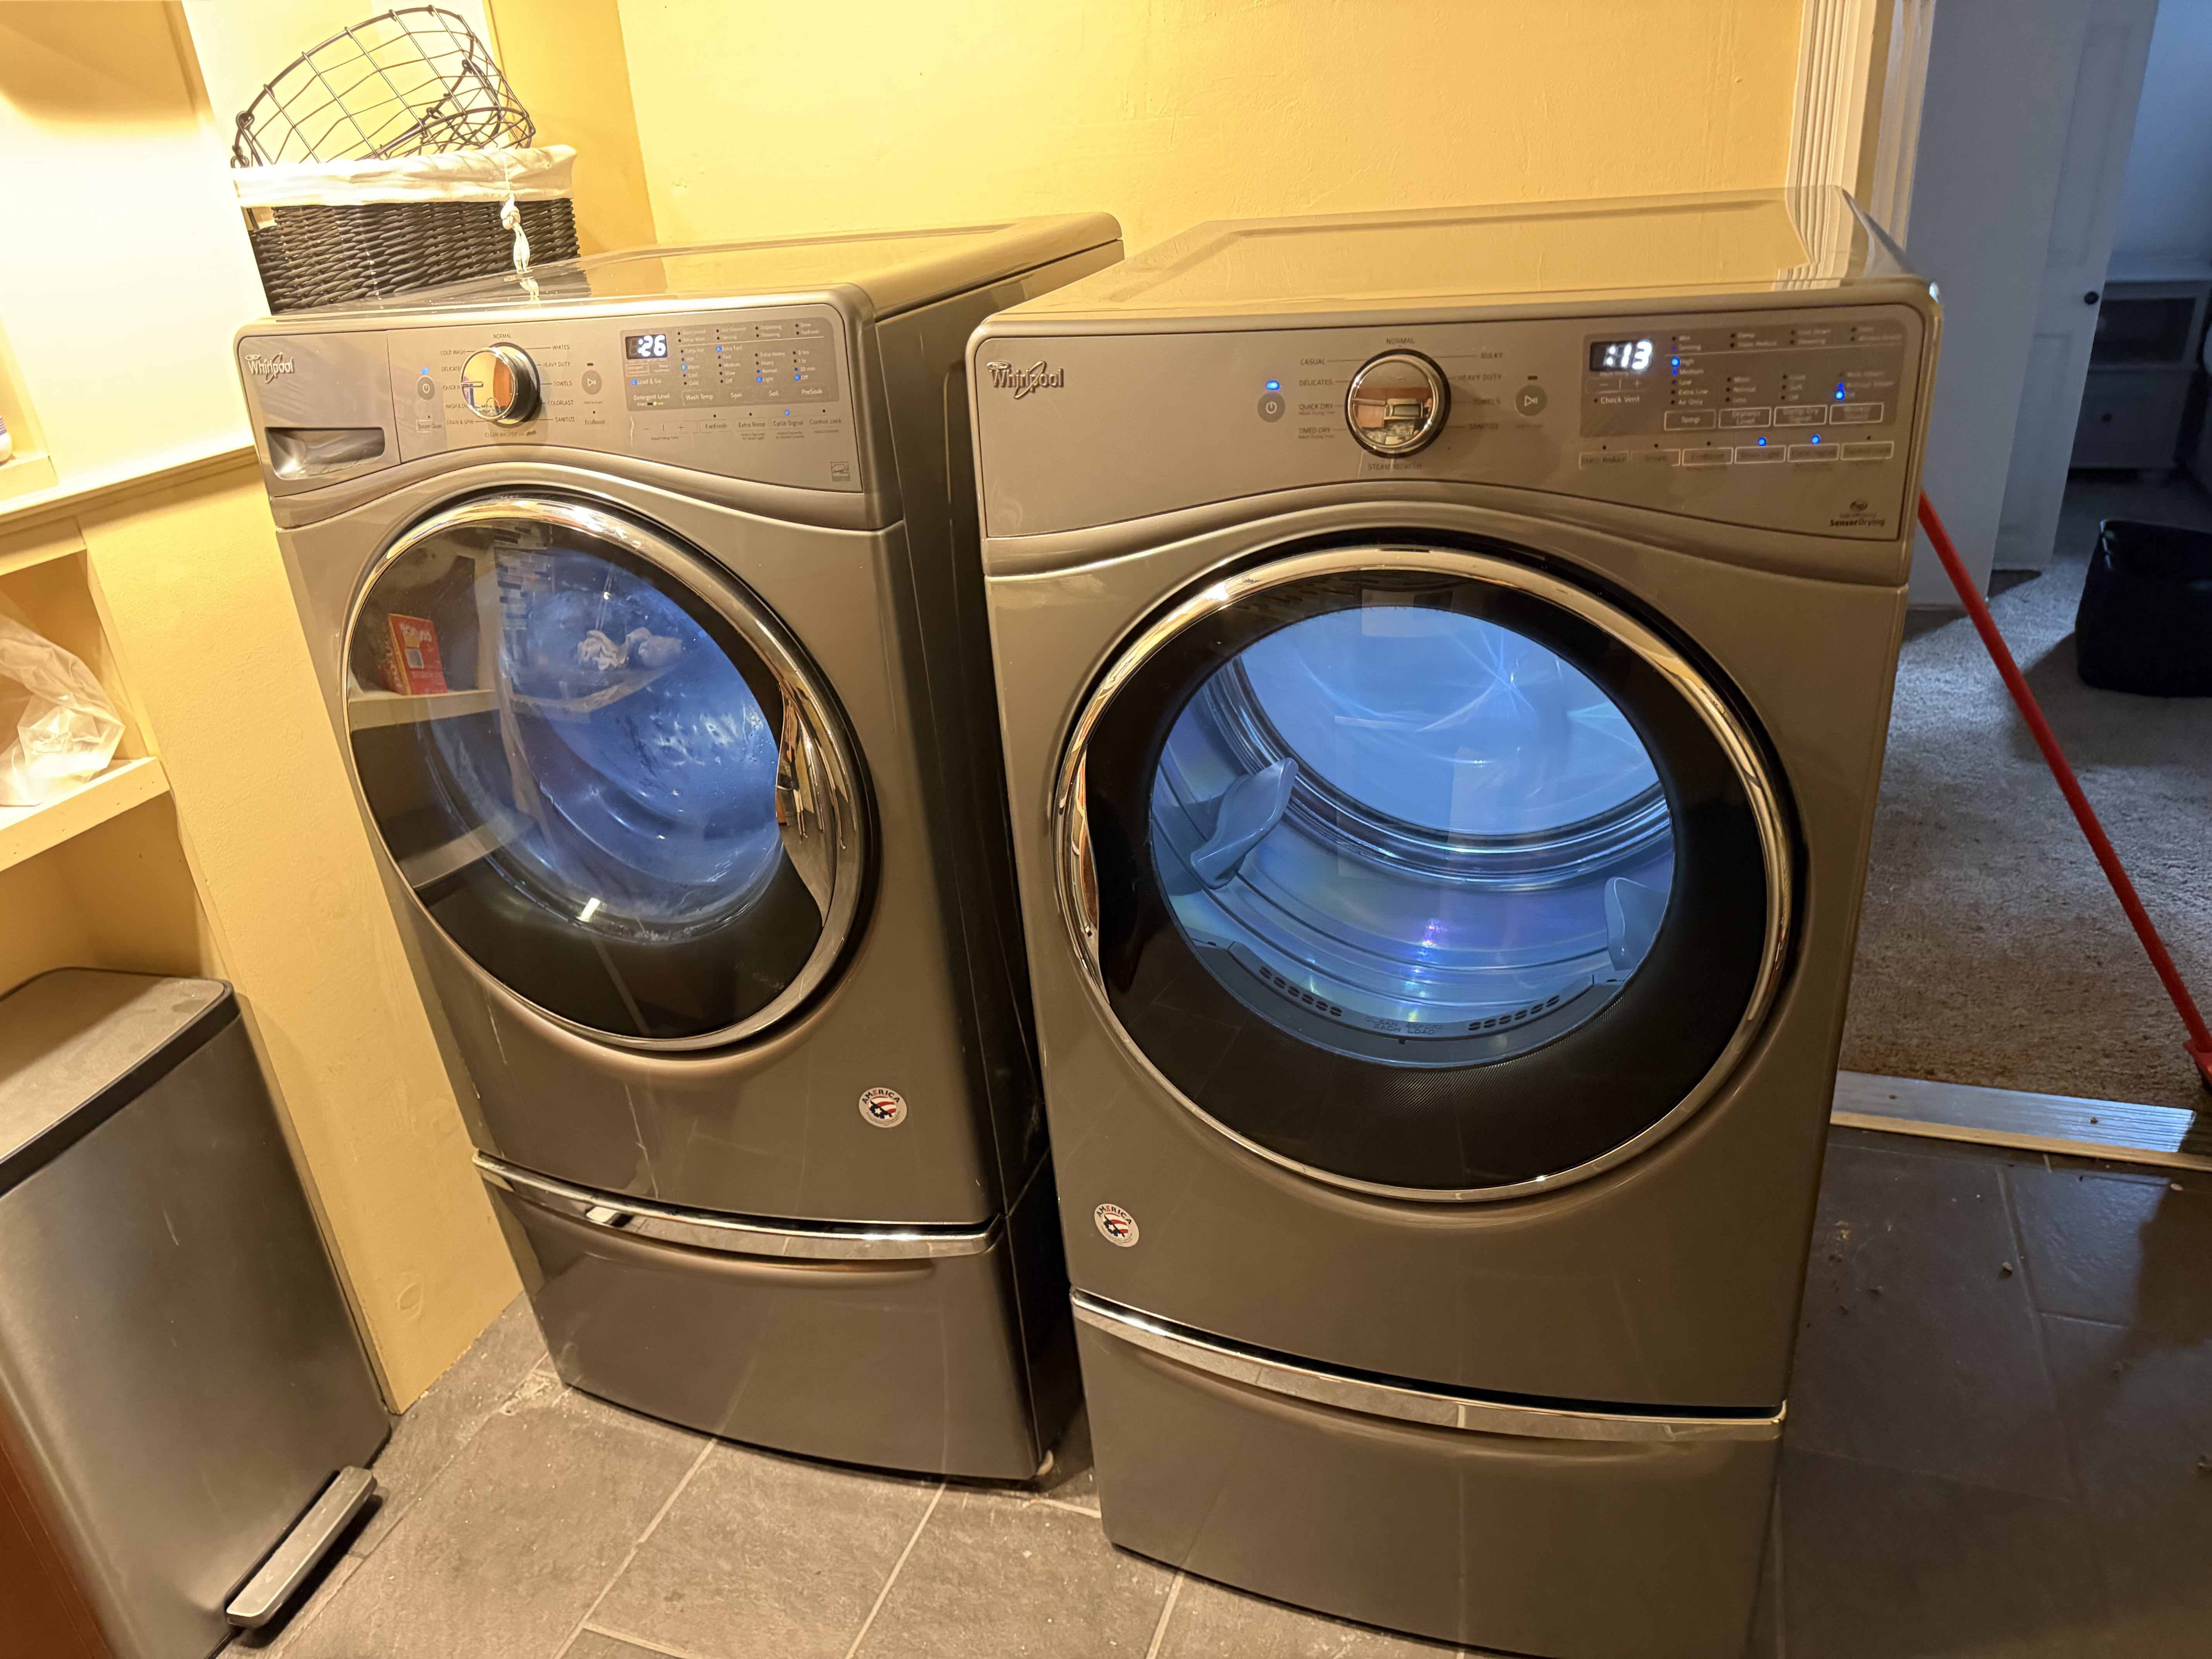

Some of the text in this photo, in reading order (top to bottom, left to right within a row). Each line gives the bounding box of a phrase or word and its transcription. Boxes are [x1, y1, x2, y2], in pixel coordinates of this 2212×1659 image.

[247, 354, 294, 381] Whirlpool
[988, 364, 1065, 397] Whirlpool
[731, 392, 742, 401] Spin
[1600, 395, 1640, 404] Check Vent
[1681, 416, 1700, 425] Temp
[1365, 1016, 1398, 1026] CLEAN
[1374, 1023, 1401, 1032] EACH
[862, 1089, 900, 1104] AMERICA
[1096, 1206, 1132, 1225] AMERICA
